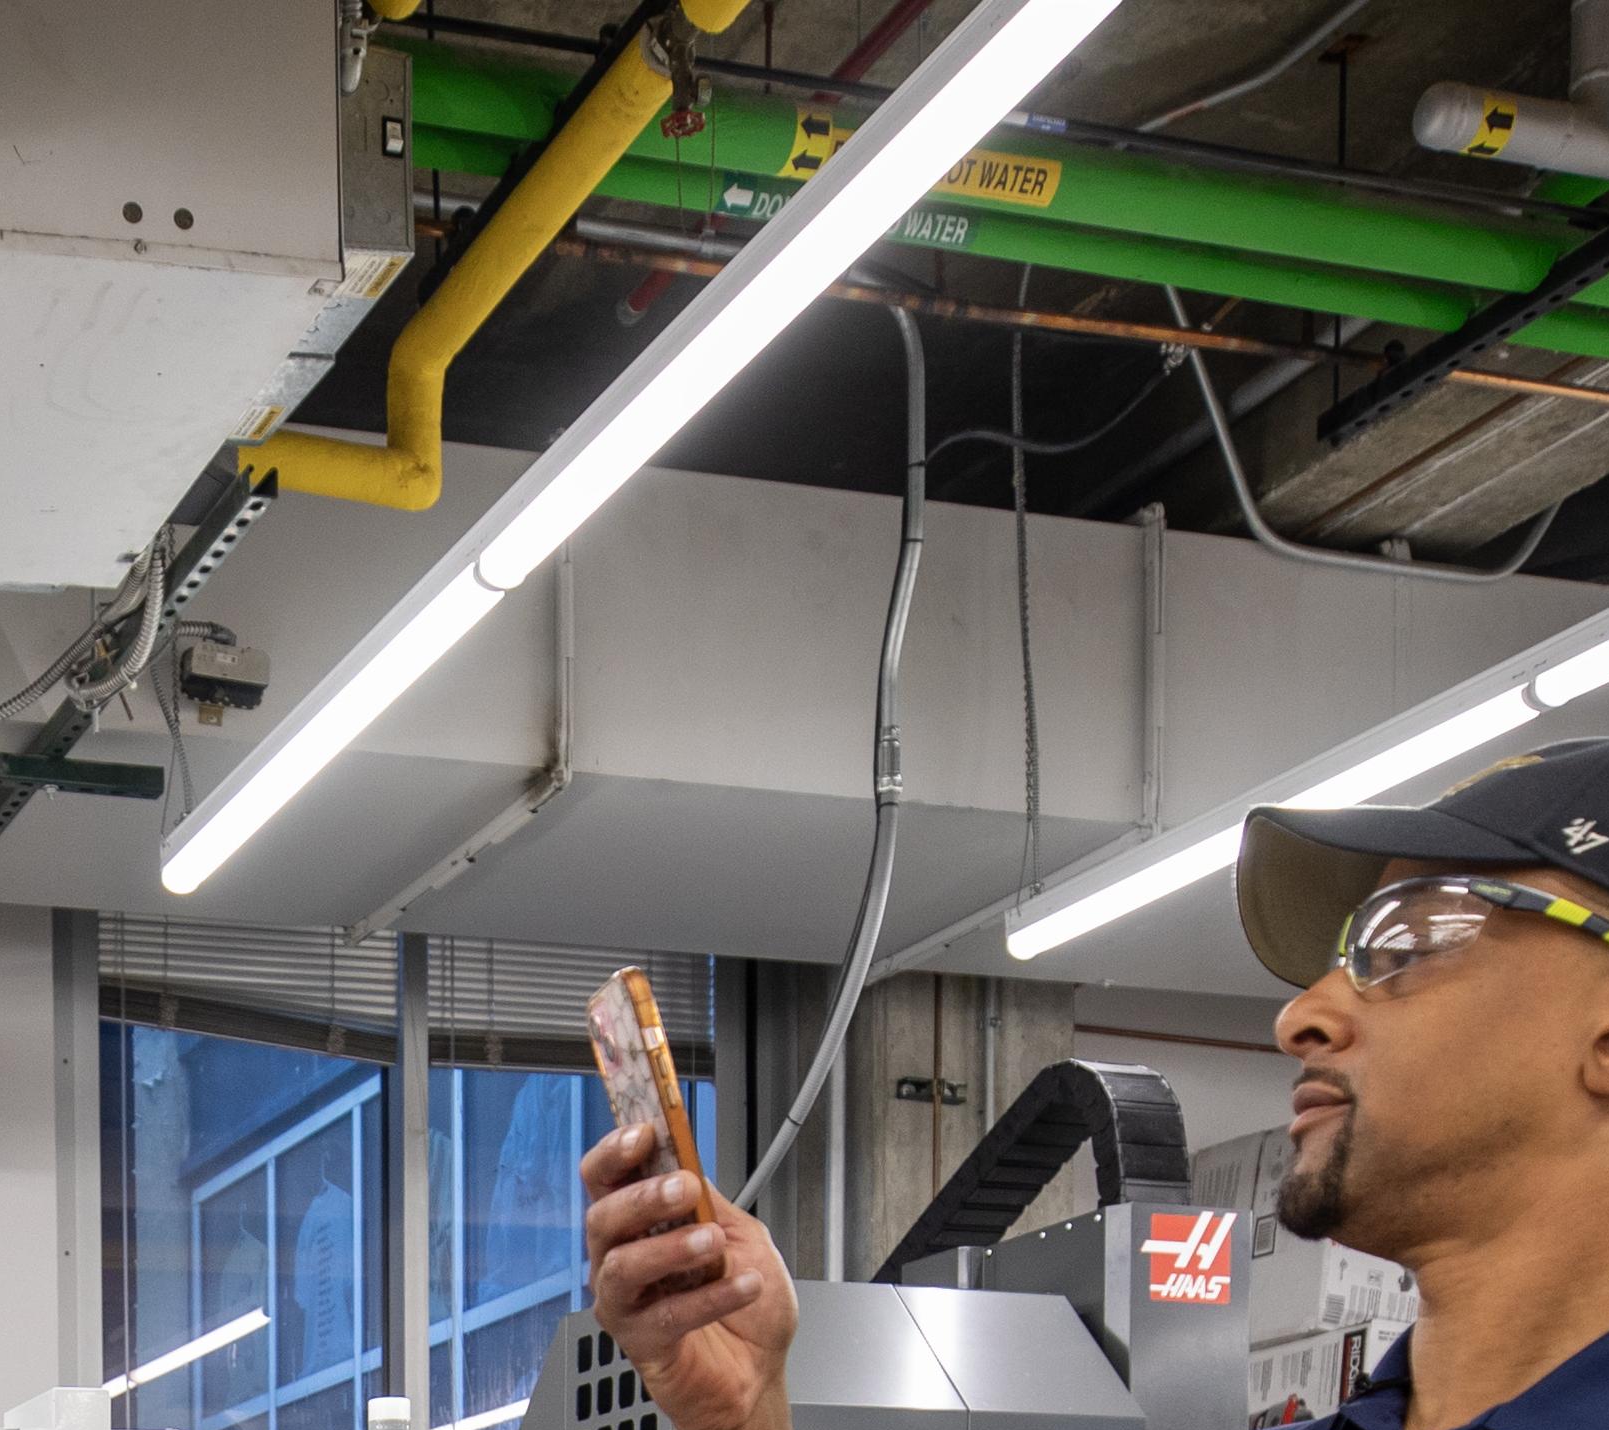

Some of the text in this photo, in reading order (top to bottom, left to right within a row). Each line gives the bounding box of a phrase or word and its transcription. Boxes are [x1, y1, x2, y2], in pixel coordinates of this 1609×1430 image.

[980, 160, 1048, 196] WATER
[904, 210, 968, 245] WATER
[1149, 1273, 1231, 1300] HAAS
